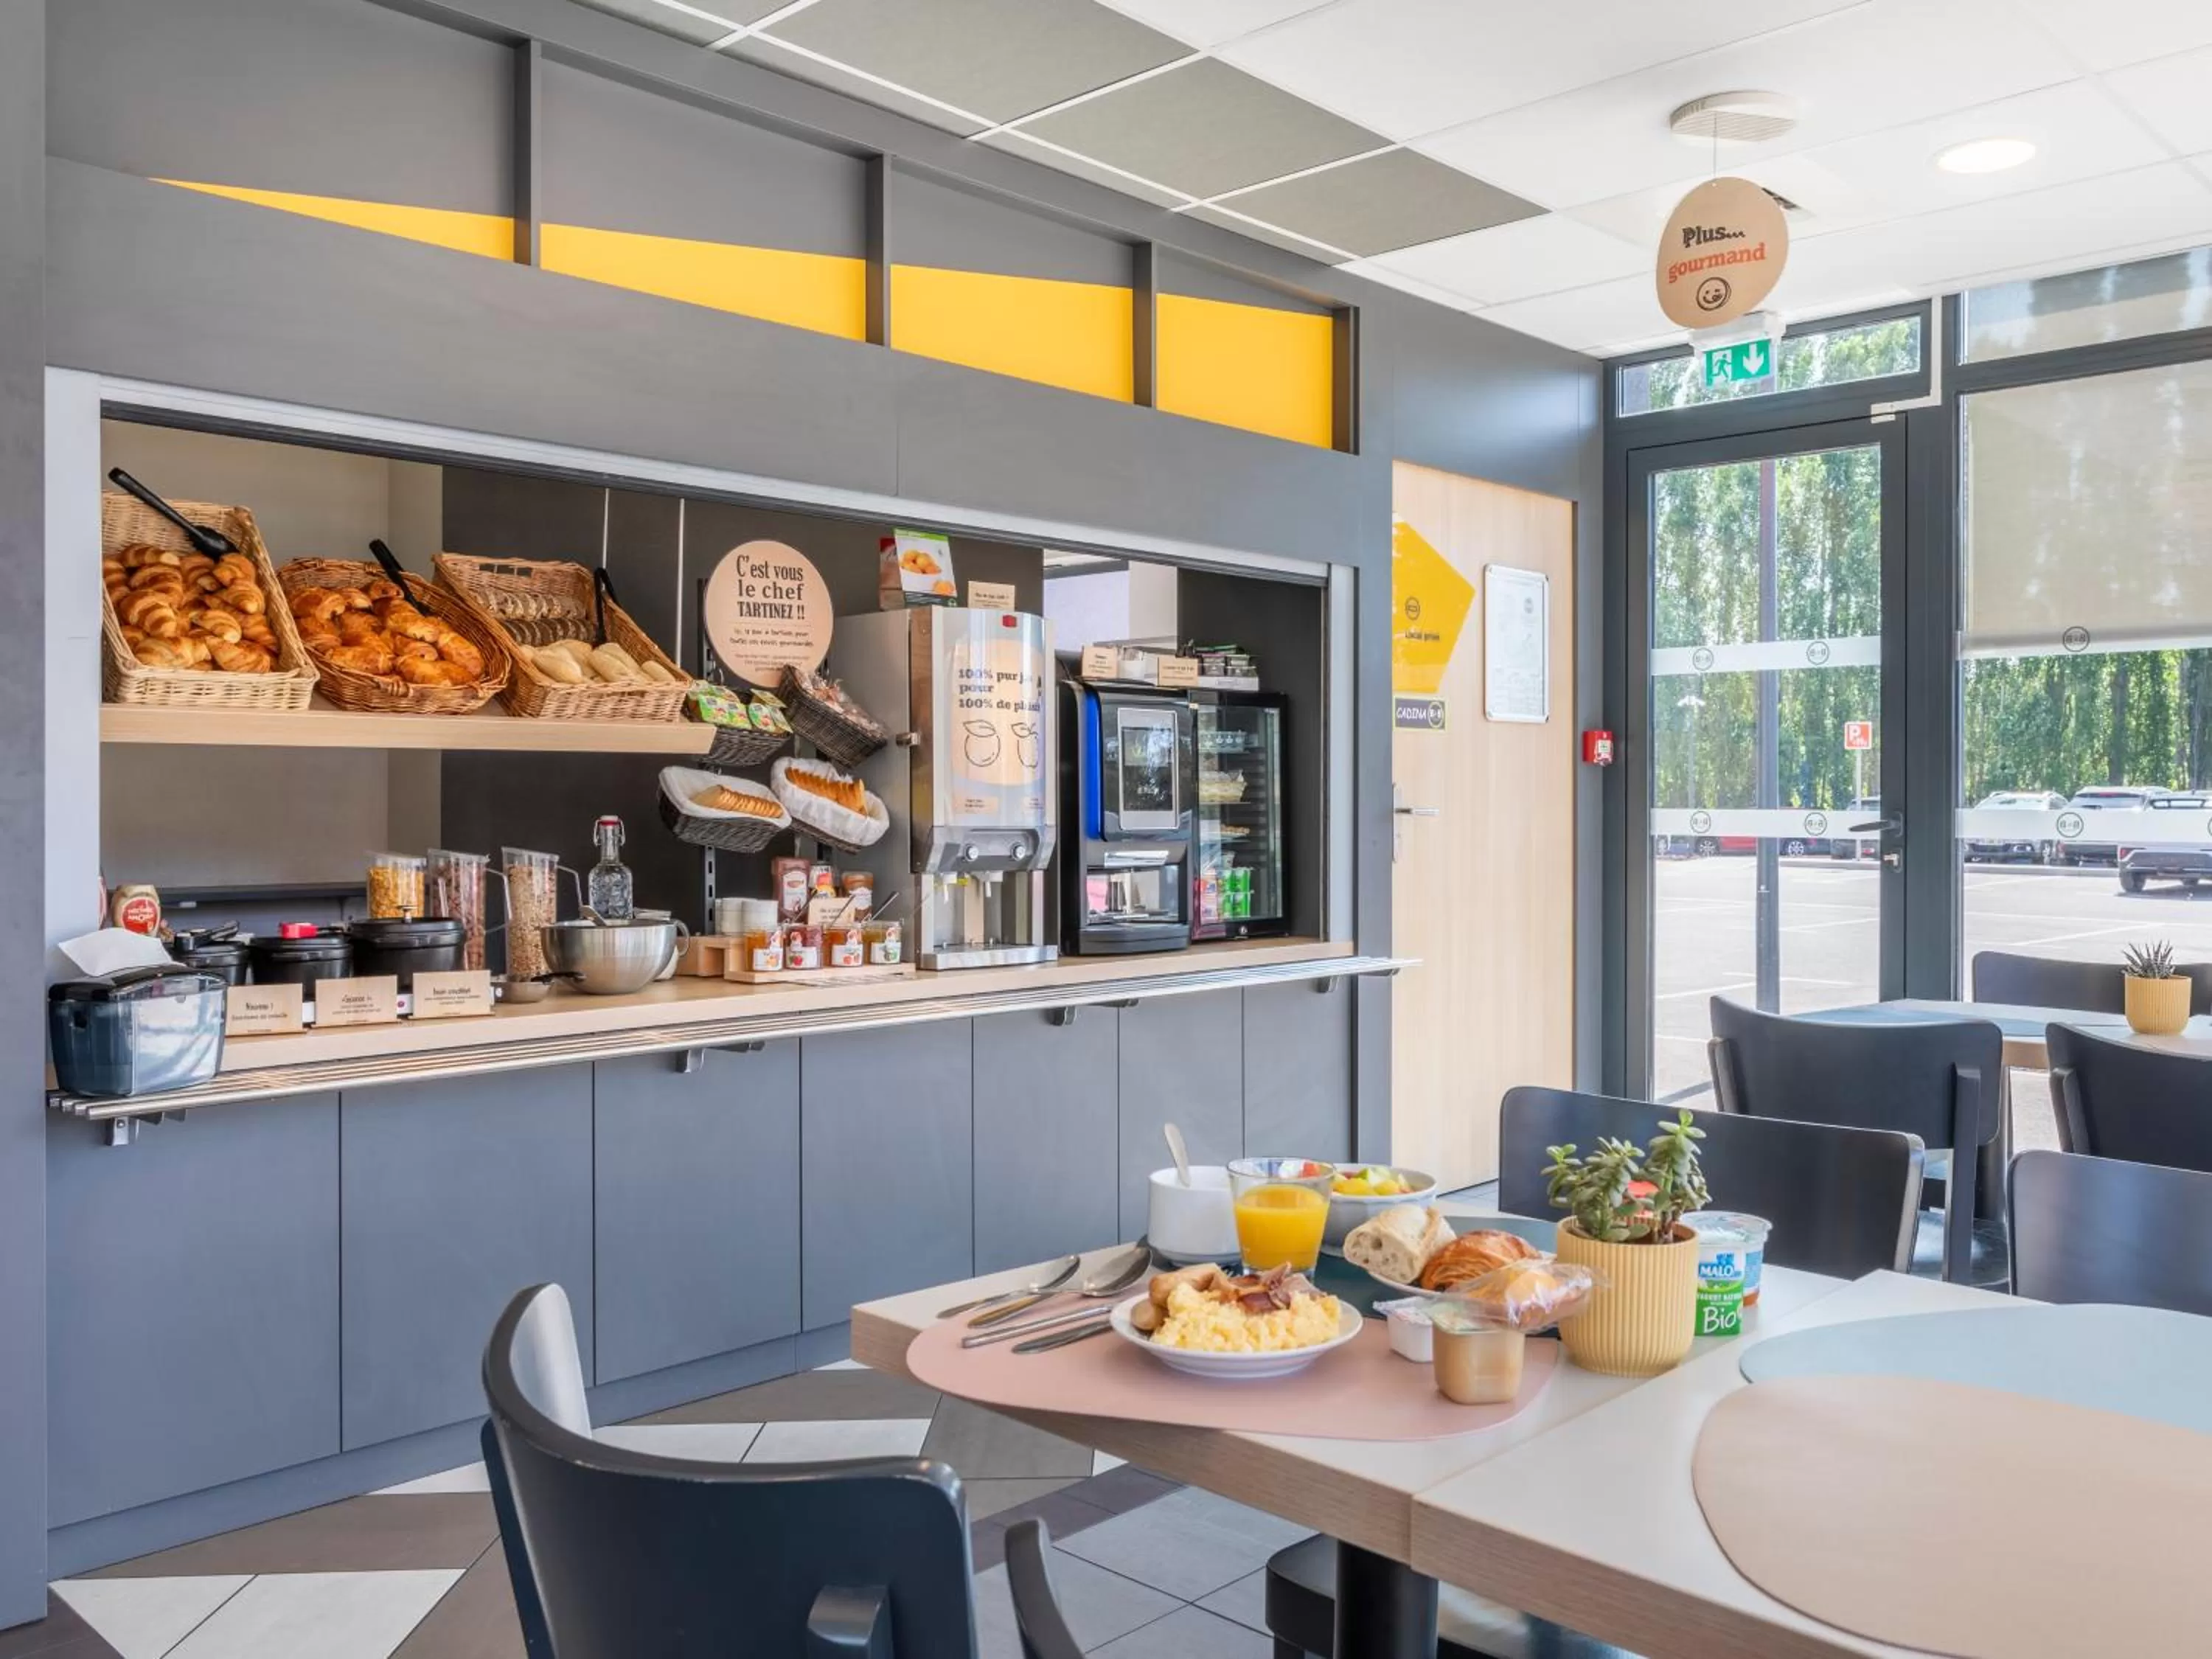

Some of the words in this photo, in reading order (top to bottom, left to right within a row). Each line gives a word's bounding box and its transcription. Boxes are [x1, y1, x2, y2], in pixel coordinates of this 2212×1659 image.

[1669, 242, 1767, 284] gourmand
[737, 554, 770, 579] C'est
[774, 566, 803, 581] vous
[738, 579, 755, 597] le
[762, 582, 804, 600] chef
[737, 602, 793, 619] TARTINEZ
[959, 669, 993, 678] 100%
[997, 672, 1018, 683] pur
[959, 684, 994, 695] pour
[959, 698, 993, 708] 100%
[996, 700, 1011, 709] de
[1699, 1265, 1733, 1276] MALO
[1703, 1306, 1737, 1333] Bio
